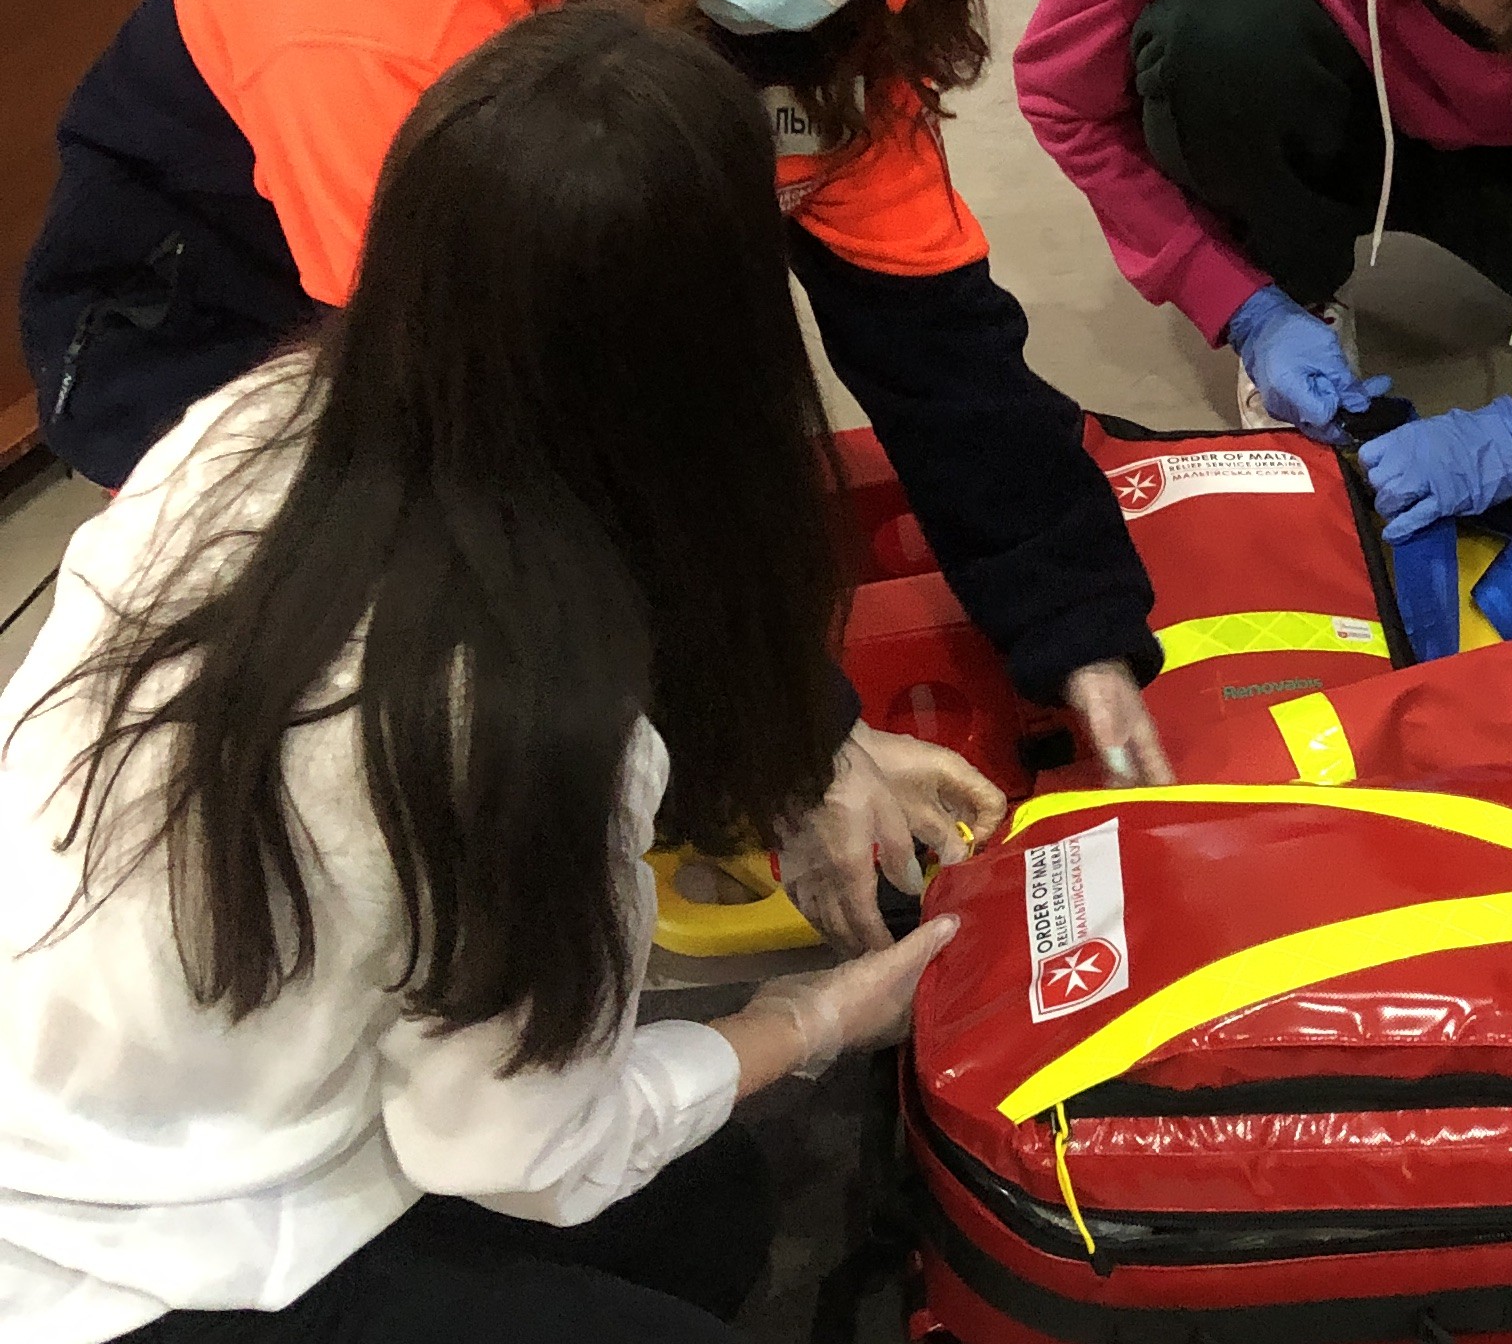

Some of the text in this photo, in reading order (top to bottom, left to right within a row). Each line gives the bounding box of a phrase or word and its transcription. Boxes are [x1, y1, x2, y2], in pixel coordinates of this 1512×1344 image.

[1167, 453, 1300, 464] ORDER OF MALTA
[1032, 879, 1047, 899] OF
[1052, 870, 1065, 913] SERVICE
[1034, 901, 1053, 953] ORDER
[1055, 913, 1068, 948] RELIEF
